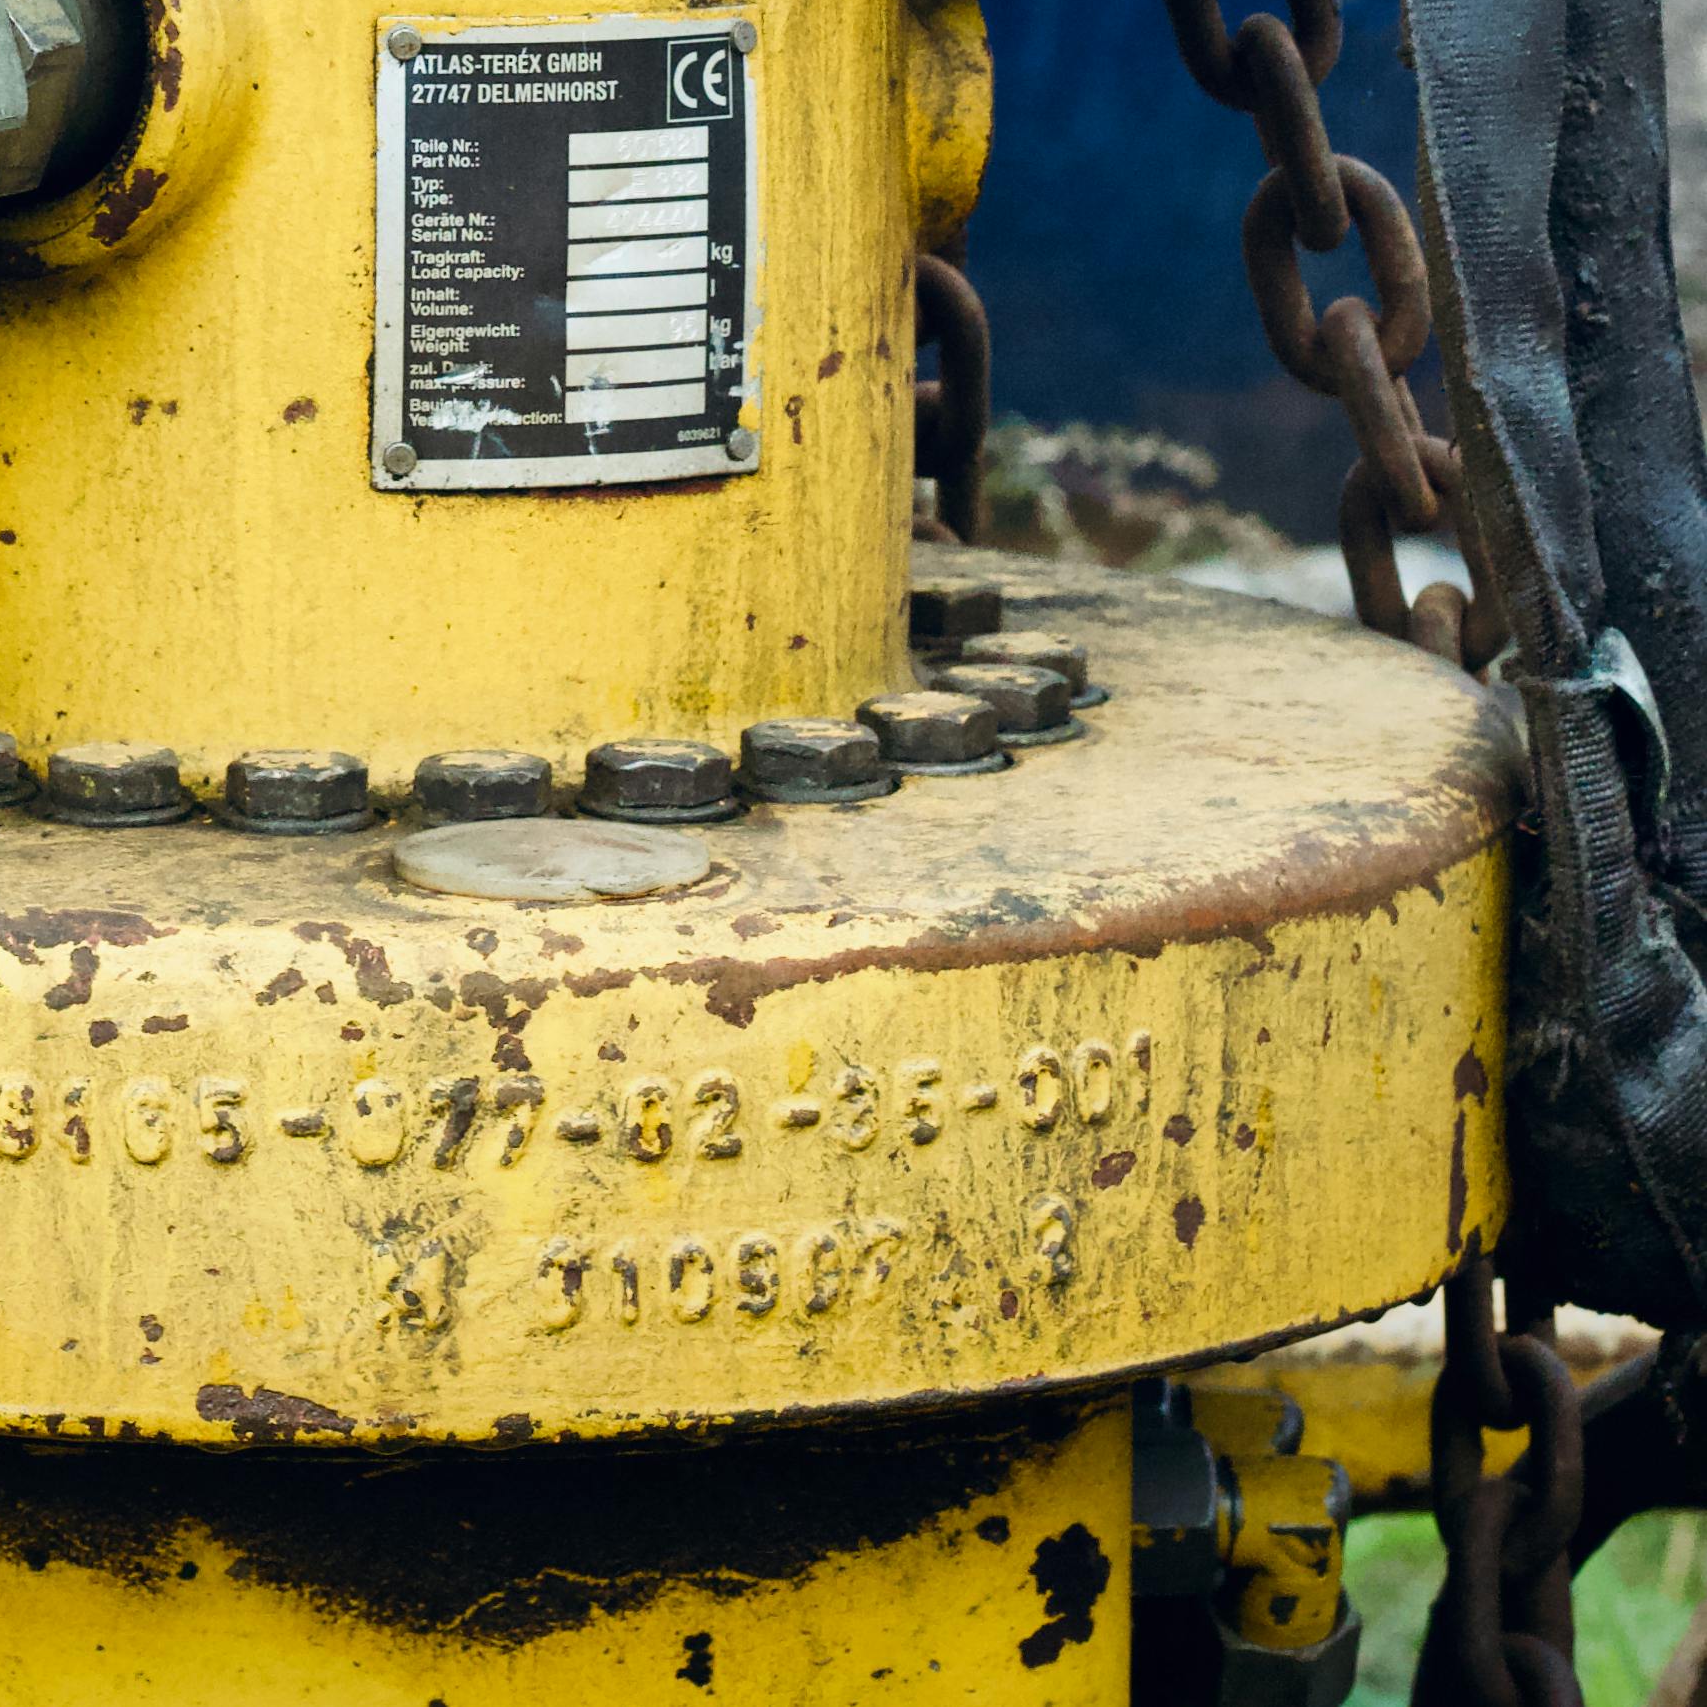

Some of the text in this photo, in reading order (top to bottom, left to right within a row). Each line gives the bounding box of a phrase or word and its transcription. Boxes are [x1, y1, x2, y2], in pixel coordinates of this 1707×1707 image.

[547, 52, 602, 73] GMBH
[673, 48, 727, 109] CE
[412, 80, 620, 104] 27747 DELMENHORST
[411, 138, 479, 153] Teile Nr.:
[411, 154, 481, 168] Part No.:
[411, 176, 444, 194] Typ:
[411, 191, 453, 208] Type:
[411, 212, 496, 227] Geräte Nr.:
[411, 228, 493, 242] Serial No.:
[411, 250, 486, 267] Tragkraft:
[710, 242, 734, 264] kg
[411, 264, 525, 281] Load capacity:
[411, 287, 460, 301] Inhalt:
[411, 302, 474, 316] Volume:
[410, 323, 521, 341] Eigengewicht:
[709, 316, 732, 337] kg
[410, 339, 470, 356] Weight:
[409, 361, 437, 375] zul.
